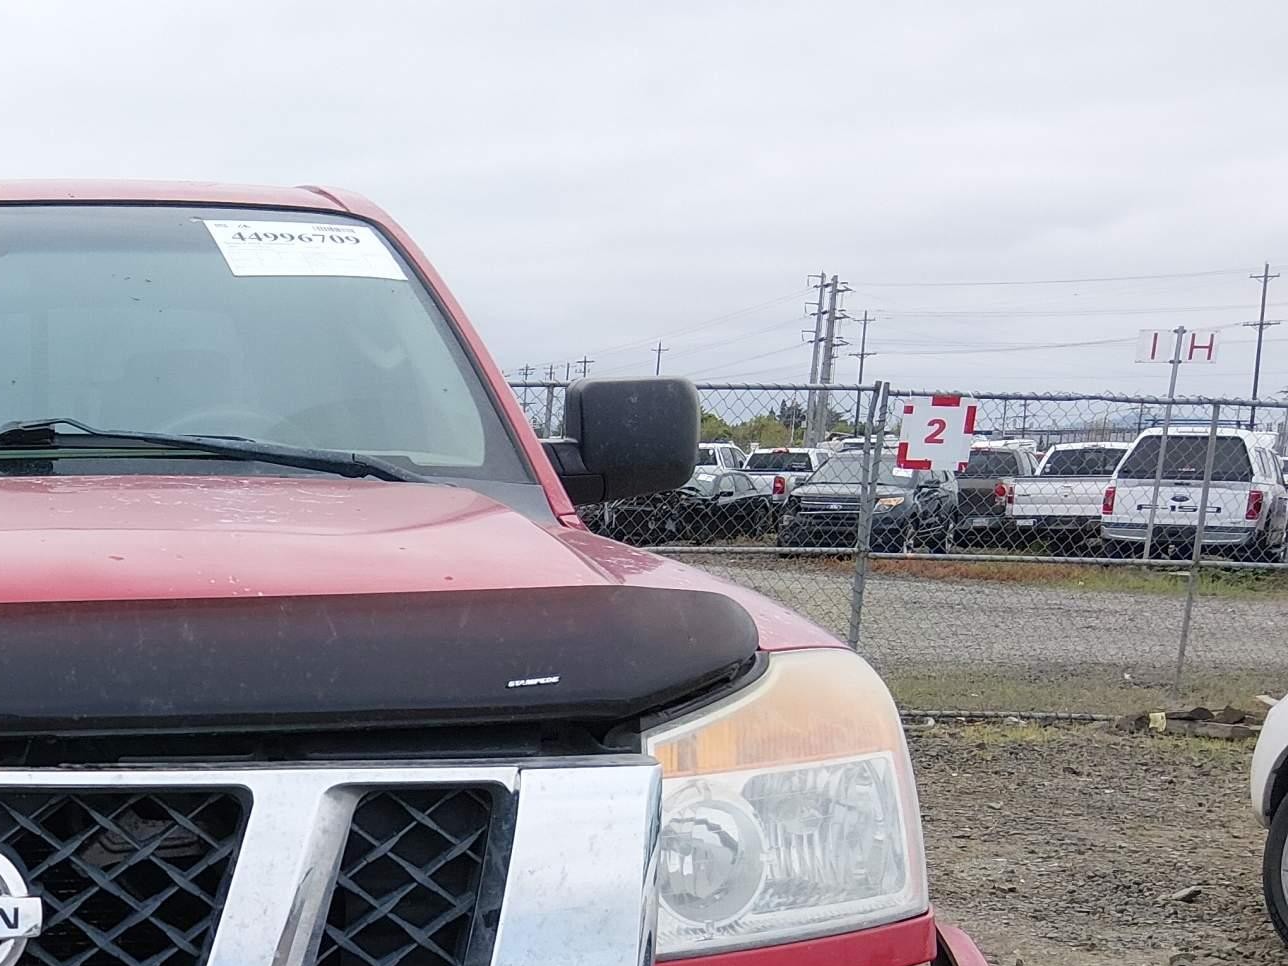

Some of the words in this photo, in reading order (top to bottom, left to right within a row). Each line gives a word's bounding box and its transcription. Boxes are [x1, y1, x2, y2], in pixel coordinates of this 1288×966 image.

[231, 230, 361, 245] 44996709
[1187, 332, 1215, 361] H
[924, 418, 947, 444] 2
